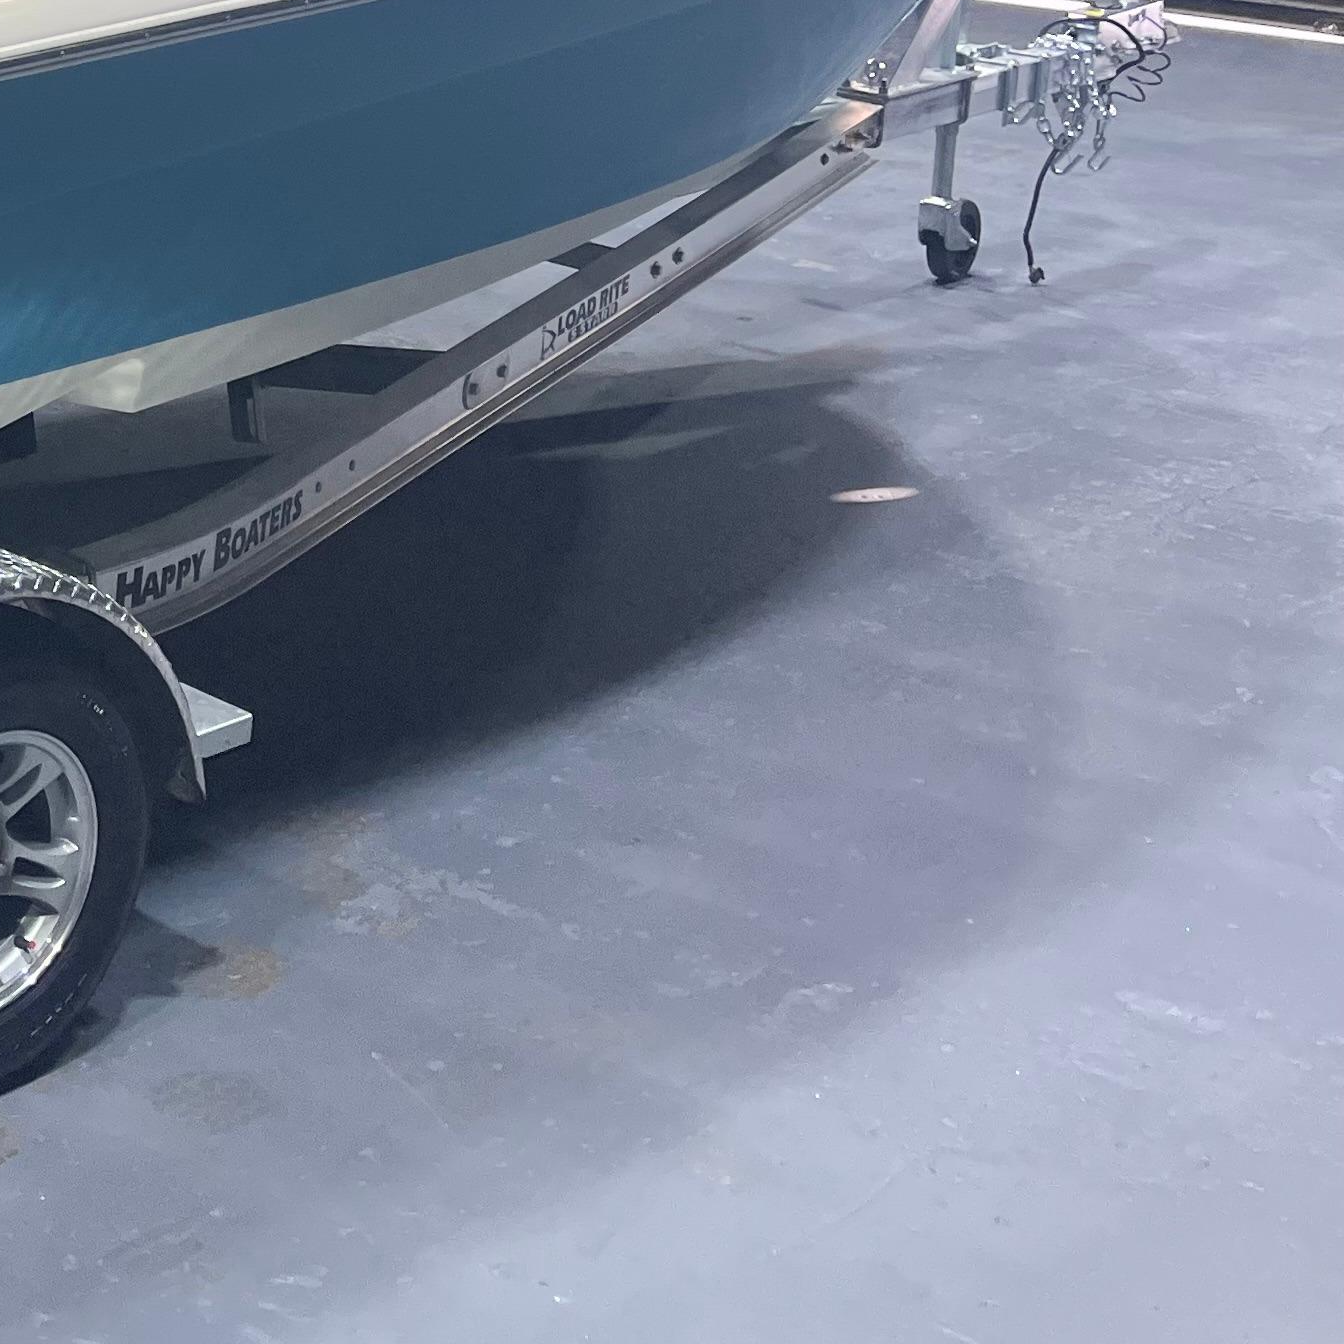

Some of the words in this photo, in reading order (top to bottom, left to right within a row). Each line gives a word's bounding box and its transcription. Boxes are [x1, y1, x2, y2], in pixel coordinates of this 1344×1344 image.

[557, 296, 597, 337] LOAD
[599, 273, 631, 310] RITE
[115, 548, 206, 609] HAPPY
[213, 488, 304, 572] BOATERS
